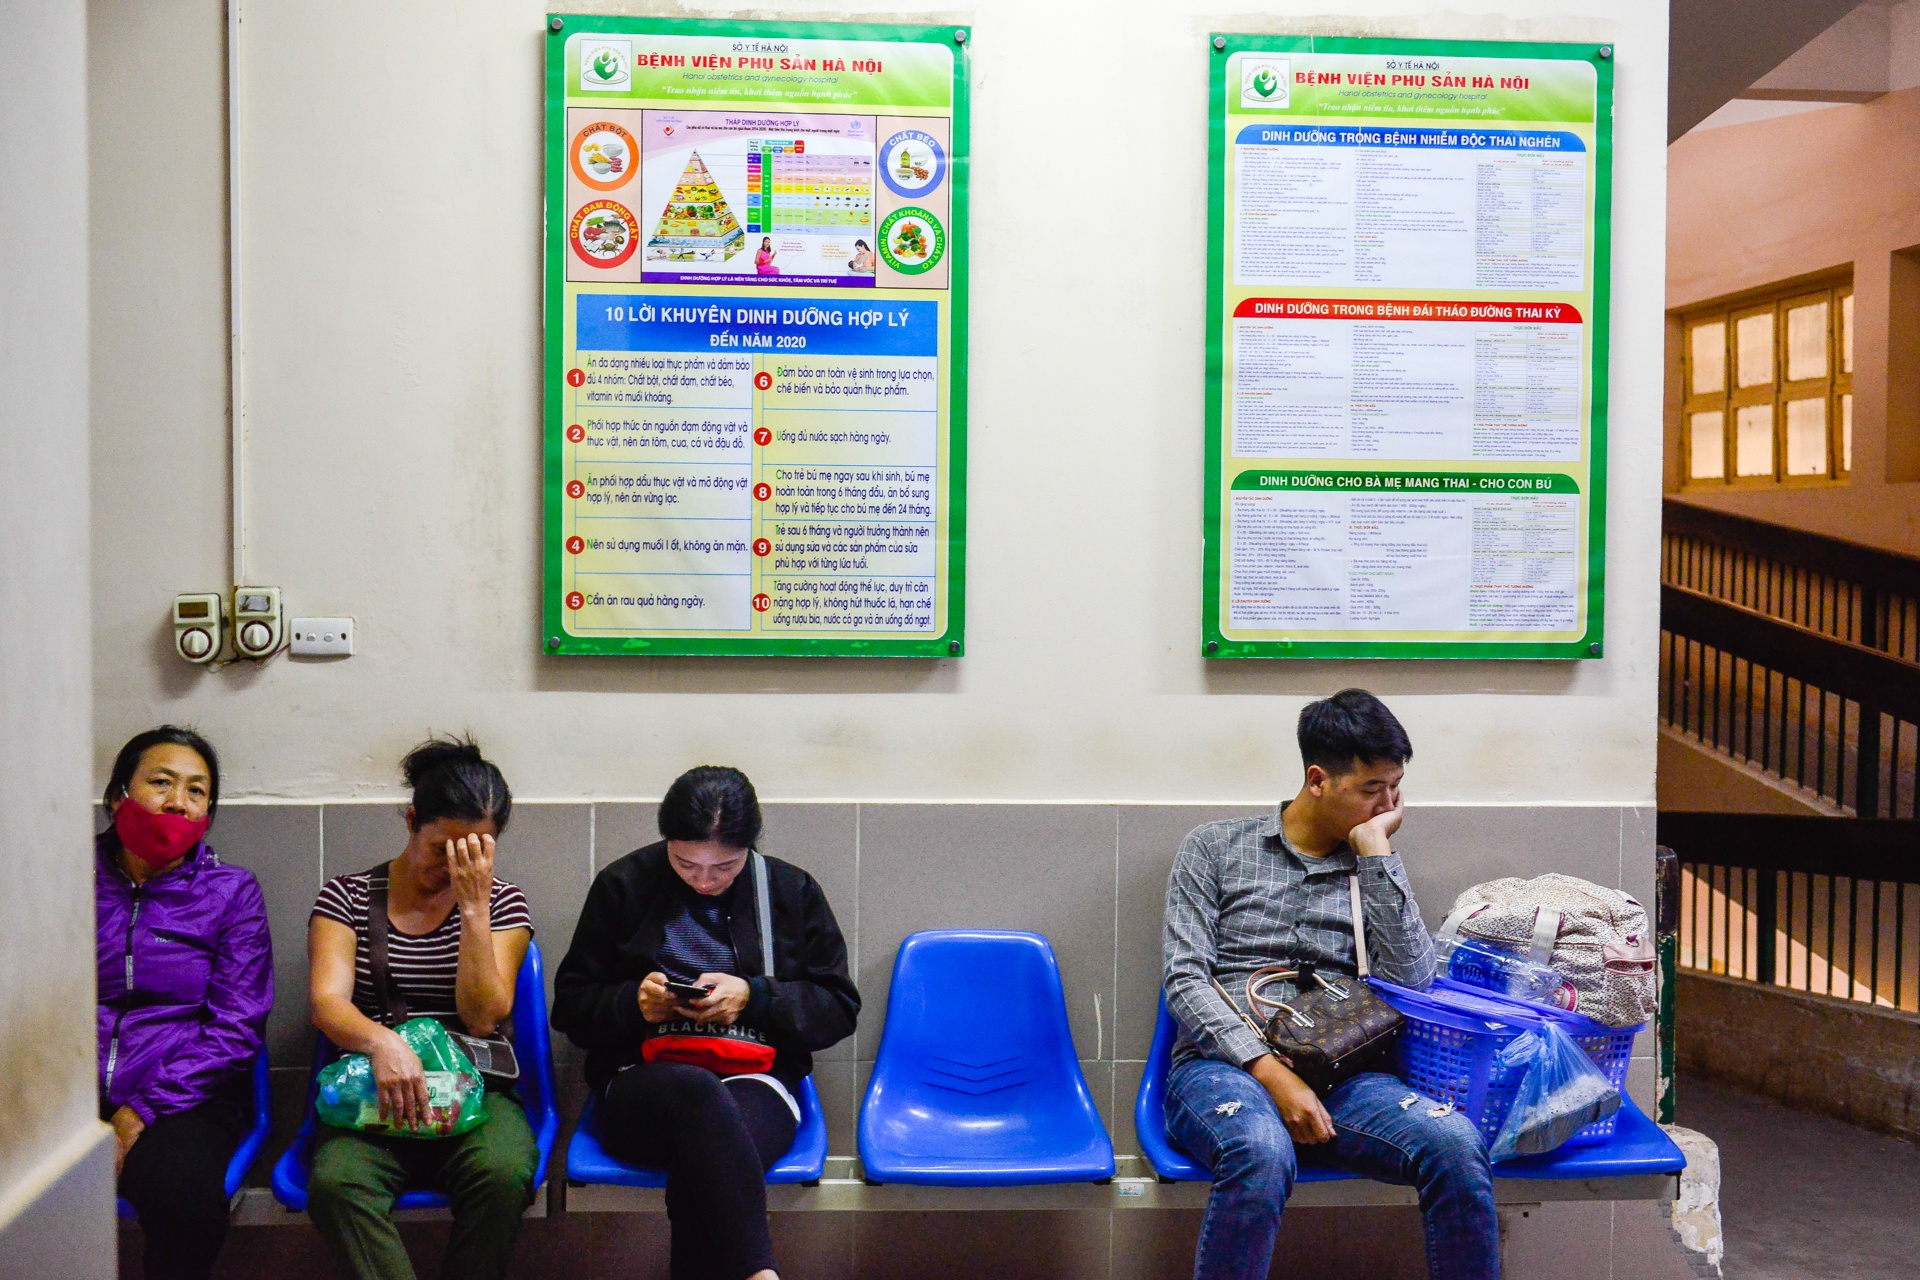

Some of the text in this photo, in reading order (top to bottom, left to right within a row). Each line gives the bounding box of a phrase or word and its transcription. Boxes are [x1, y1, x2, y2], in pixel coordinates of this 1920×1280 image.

[732, 42, 742, 51] SỞ
[752, 42, 760, 52] TẾ
[762, 43, 772, 52] HÀ
[774, 44, 788, 53] NỘI
[638, 52, 685, 69] BỆNH
[692, 53, 732, 70] VIỆN
[738, 57, 773, 72] PHỤ
[780, 54, 816, 71] SẢN
[822, 58, 846, 72] HÀ
[852, 58, 882, 75] NỘI
[1386, 60, 1396, 69] SỞ
[1404, 60, 1412, 69] TẾ
[1414, 60, 1423, 69] HÀ
[1426, 62, 1440, 70] NỘI
[762, 76, 807, 84] gynecology
[1296, 70, 1341, 86] BỆNH
[1347, 71, 1385, 88] VIỆN
[1392, 75, 1425, 89] PHỤ
[1432, 71, 1466, 88] SẢN
[1472, 74, 1494, 88] HÀ
[1500, 76, 1529, 91] NỘI
[583, 122, 627, 138] CHẤT BỘT
[890, 130, 936, 148] CHẤT BÉO
[1262, 129, 1560, 148] DINH DƯỠNG TRONG BỆNH NHIỄM ĐỘC THAI NGHÉN
[605, 303, 909, 330] 10 LỜI KHUYÊN DINH DƯỠNG HỢP LÝ
[1255, 302, 1561, 318] DINH DƯỠNG TRONG BỆNH ĐÁI THÁO ĐƯỜNG THAI KỲ
[709, 330, 806, 349] ĐẾN NĂM 2020
[573, 373, 580, 384] 1
[760, 376, 768, 387] 6
[777, 365, 935, 383] Đảm bảo an toàn vệ sinh trong lựa chọn,
[777, 381, 909, 397] chế biến và bảo quản thực phẩm.
[572, 429, 580, 440] 2
[759, 432, 768, 442] 7
[777, 429, 891, 445] Uống đủ nước sạch hàng ngày.
[1260, 476, 1287, 486] DINH
[1291, 474, 1333, 487] DƯỠNG
[1337, 477, 1362, 487] CHO
[1365, 475, 1381, 487] BÀ
[1384, 478, 1401, 489] MẸ
[1405, 478, 1439, 487] MANG
[1443, 478, 1469, 488] THAI
[1480, 478, 1505, 489] CHO
[1508, 479, 1532, 489] CON
[1536, 477, 1552, 489] BÚ
[571, 540, 580, 551] 4
[587, 538, 603, 550] Nên
[618, 540, 640, 553] dụng
[643, 538, 664, 550] muối
[684, 539, 710, 554] không
[758, 542, 767, 553] 9
[775, 556, 868, 571] phù hợp với từng lứa tuổi.
[572, 596, 580, 606] 5
[587, 592, 604, 605] Cần
[621, 596, 634, 605] rau
[638, 594, 654, 608] quả
[657, 594, 679, 608] hàng
[681, 595, 705, 608] ngày.
[754, 598, 770, 609] 10
